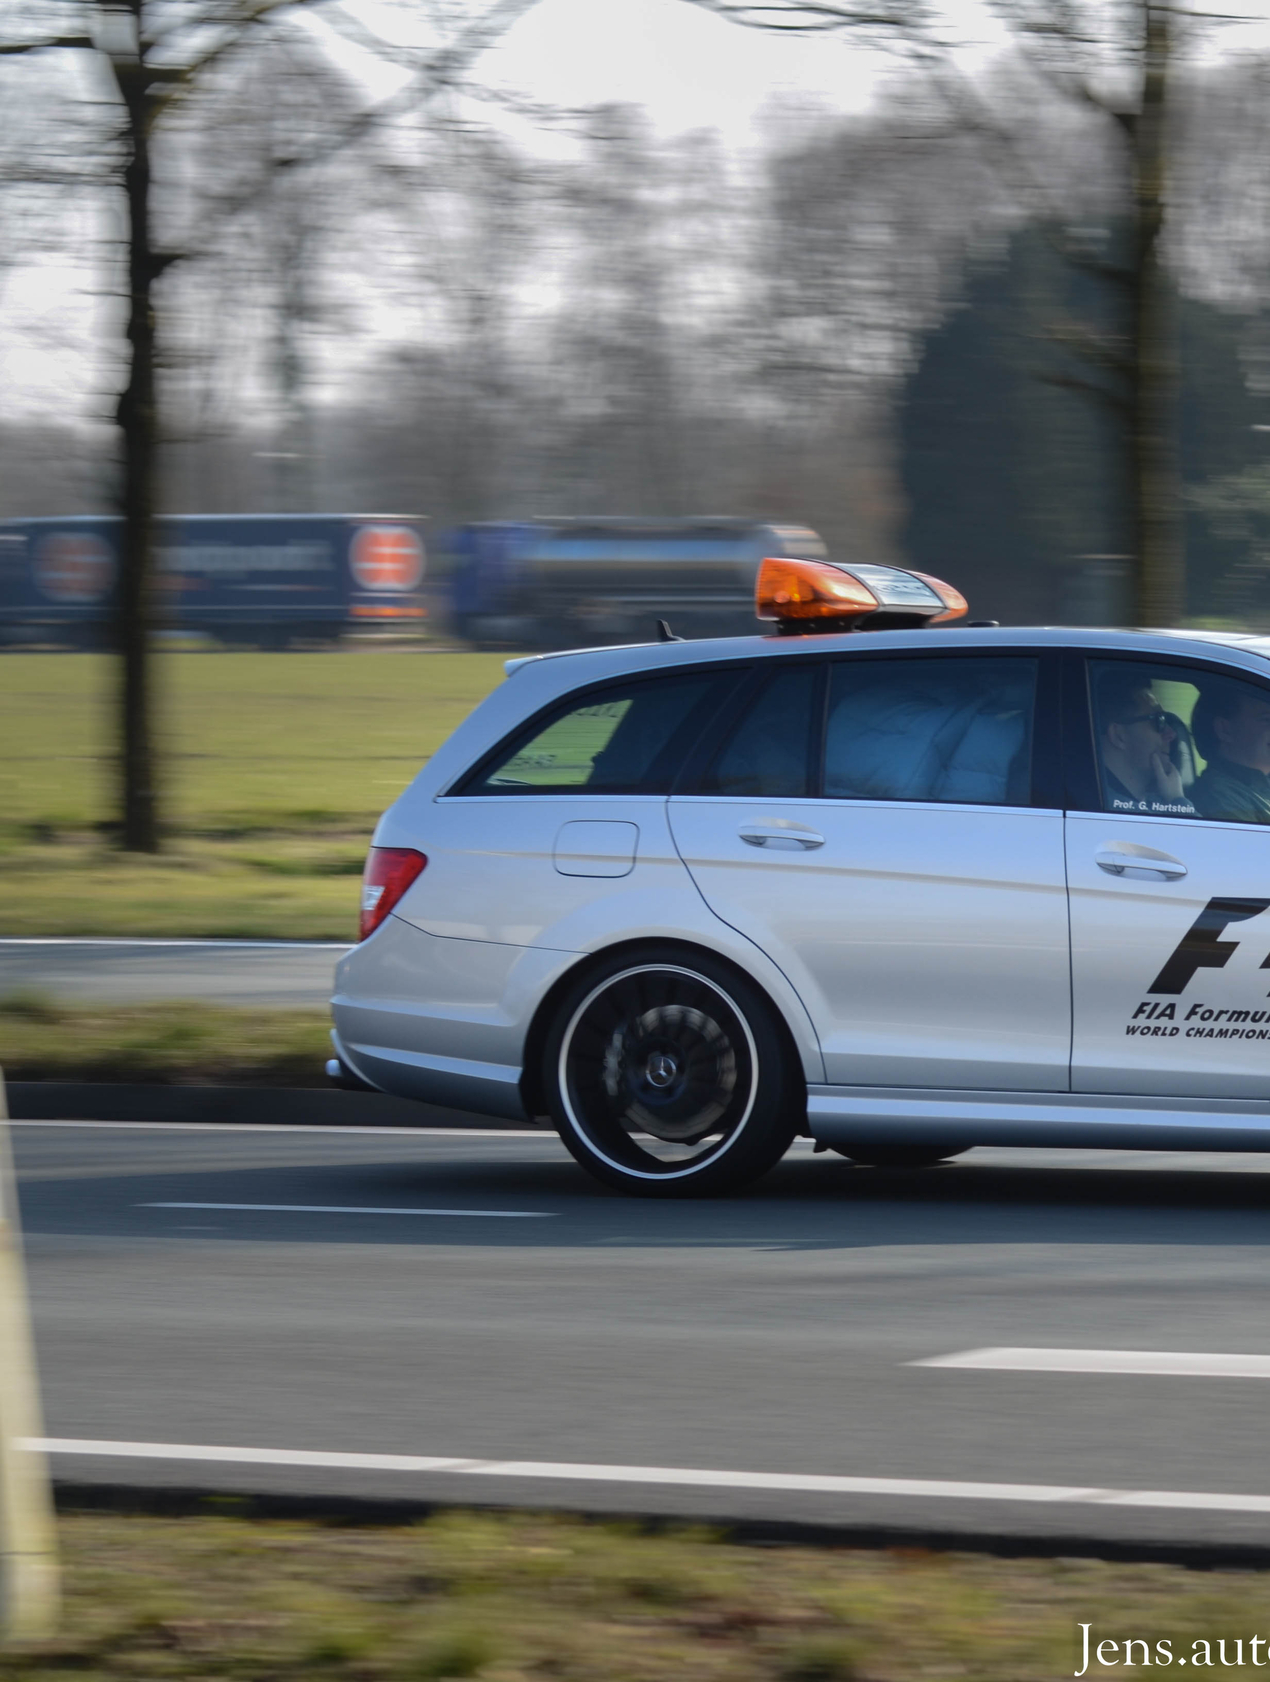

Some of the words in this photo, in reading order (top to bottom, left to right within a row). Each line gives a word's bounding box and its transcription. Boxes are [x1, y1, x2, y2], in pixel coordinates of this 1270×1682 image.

[1113, 799, 1135, 810] Prof.
[1138, 801, 1148, 811] G.
[1152, 802, 1195, 814] Hartstein
[1131, 1001, 1177, 1021] FIA
[1125, 1025, 1180, 1037] WORLD
